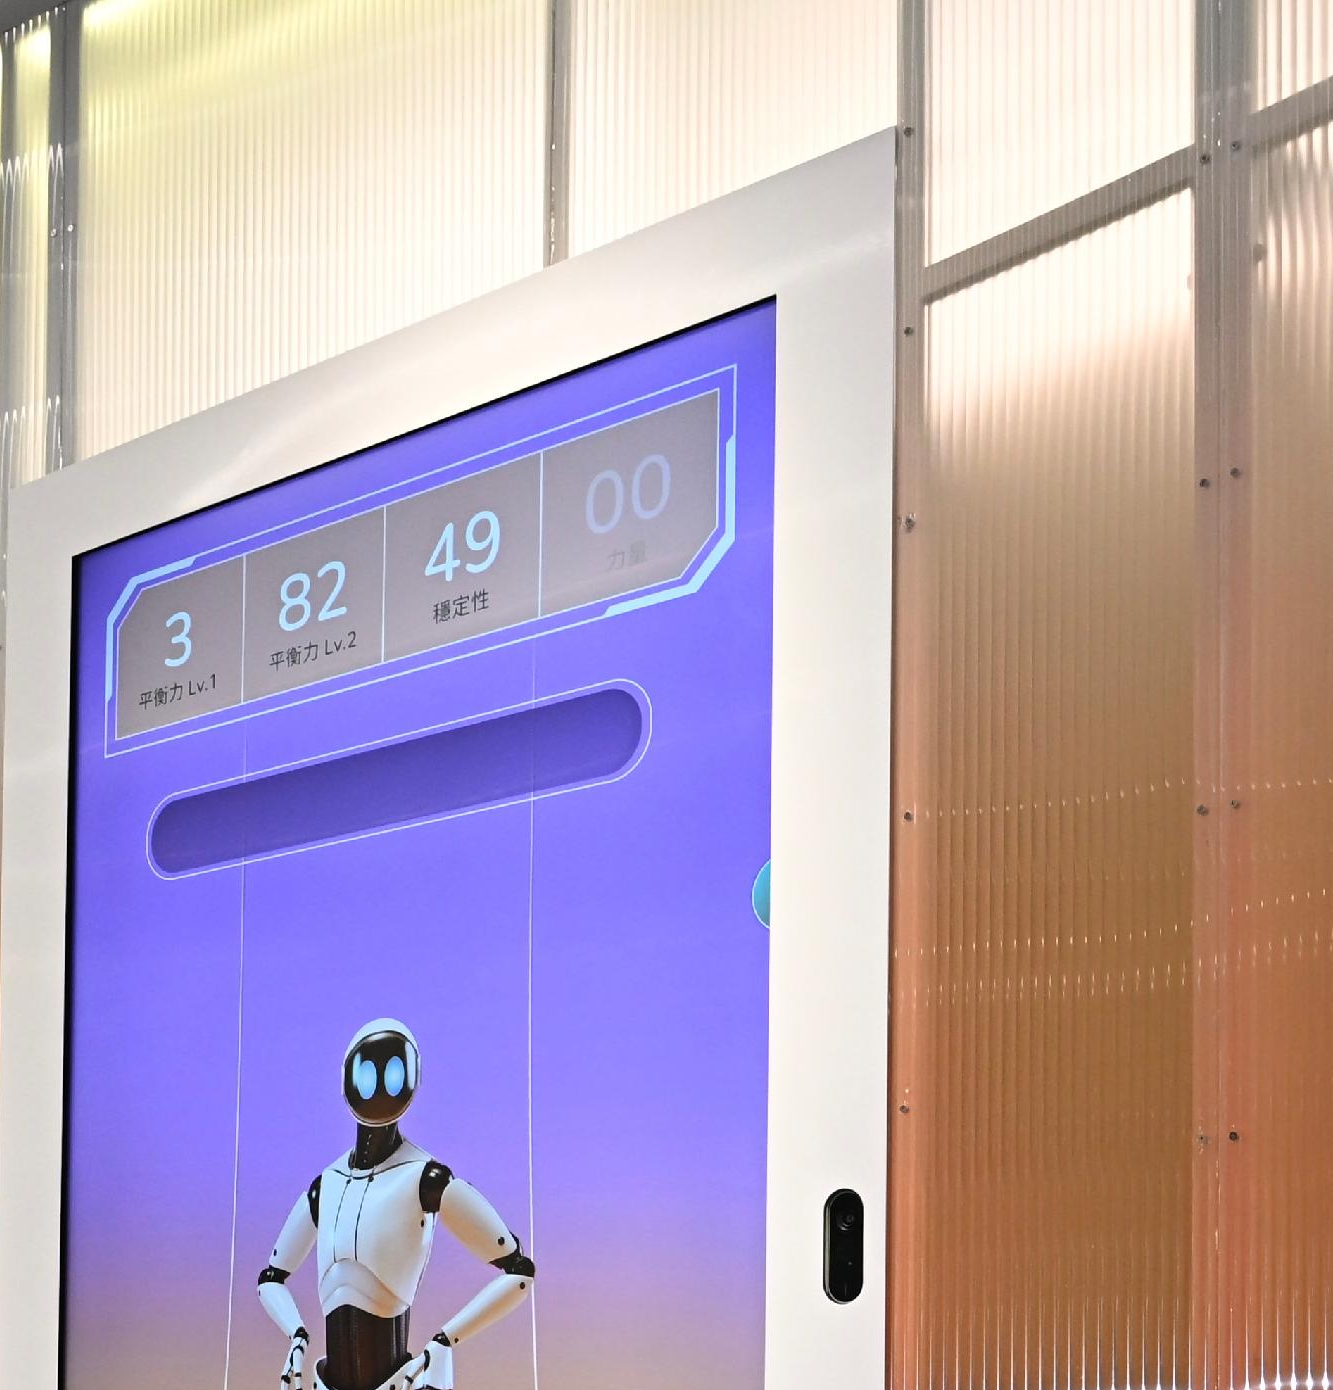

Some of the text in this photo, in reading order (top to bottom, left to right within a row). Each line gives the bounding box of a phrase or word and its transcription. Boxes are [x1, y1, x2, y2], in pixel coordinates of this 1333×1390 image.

[424, 510, 501, 582] 49
[278, 560, 348, 632] 82
[432, 588, 490, 624] 穩定性
[164, 611, 192, 667] 3
[269, 630, 357, 671] 平衡力 Lv.2
[138, 673, 216, 710] 平衡力 Lv.1
